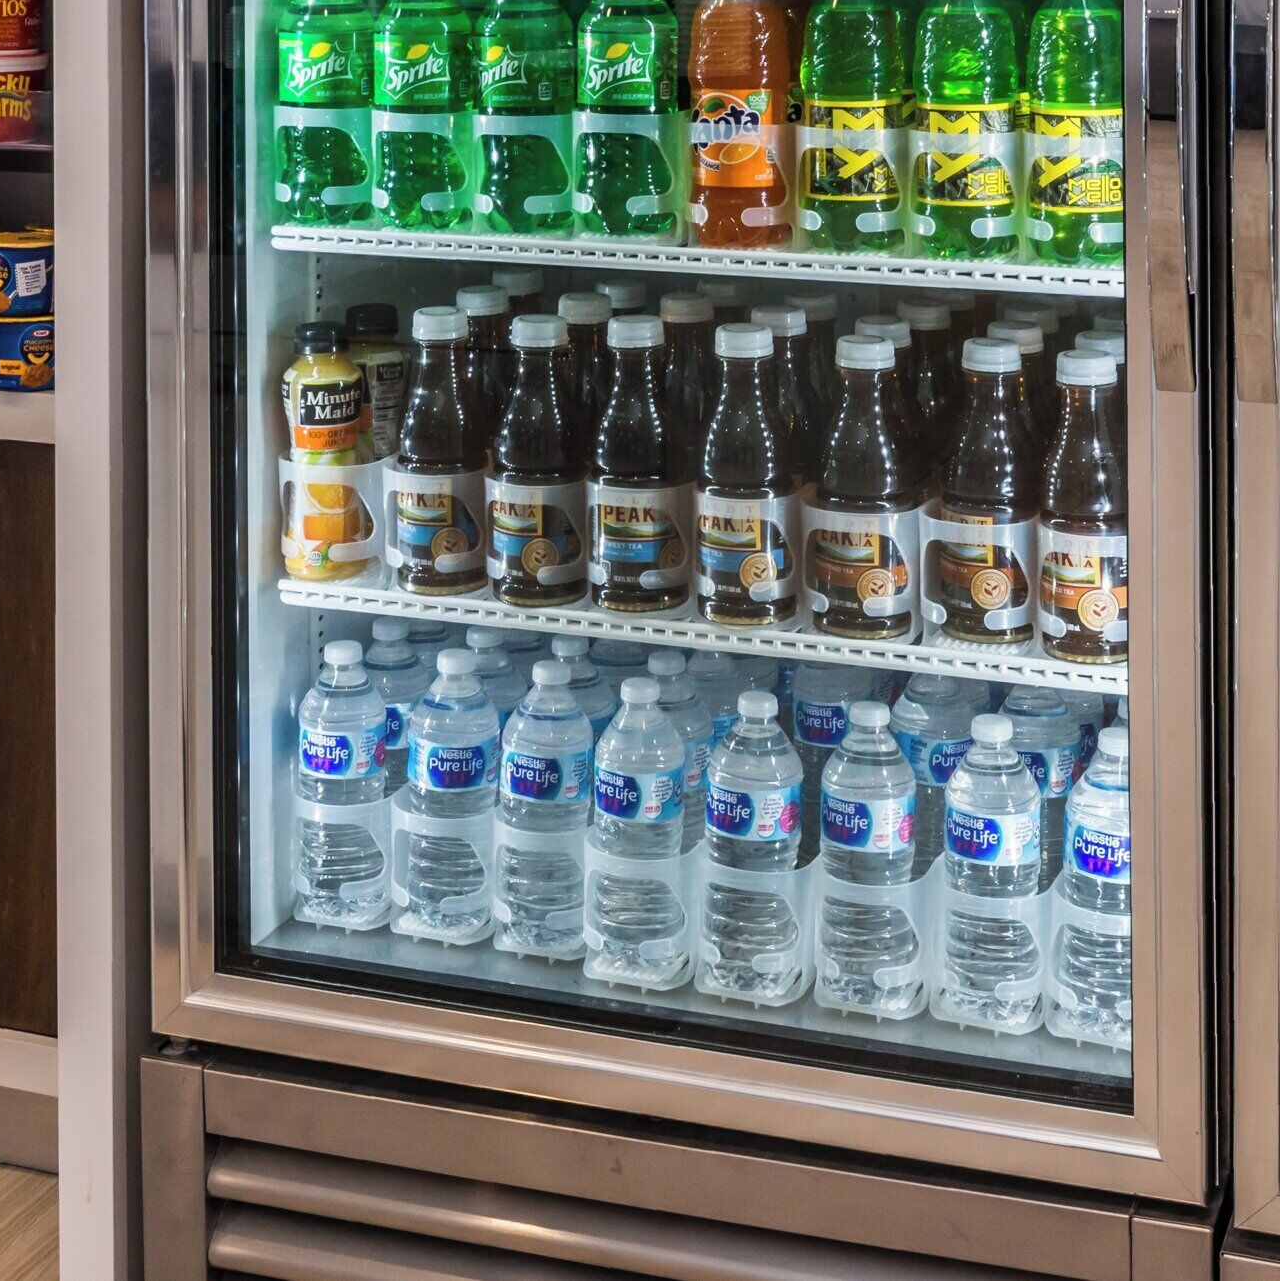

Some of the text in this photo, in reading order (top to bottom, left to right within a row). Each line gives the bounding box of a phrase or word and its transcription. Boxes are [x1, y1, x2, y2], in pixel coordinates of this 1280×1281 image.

[289, 54, 346, 89] Sprite
[386, 55, 444, 92] Sprite
[586, 55, 644, 91] Sprite
[306, 390, 361, 406] Minute
[314, 403, 354, 420] Maid
[604, 505, 654, 522] PEAK
[429, 757, 483, 775] Pure Life
[1075, 836, 1131, 866] Pure Life
